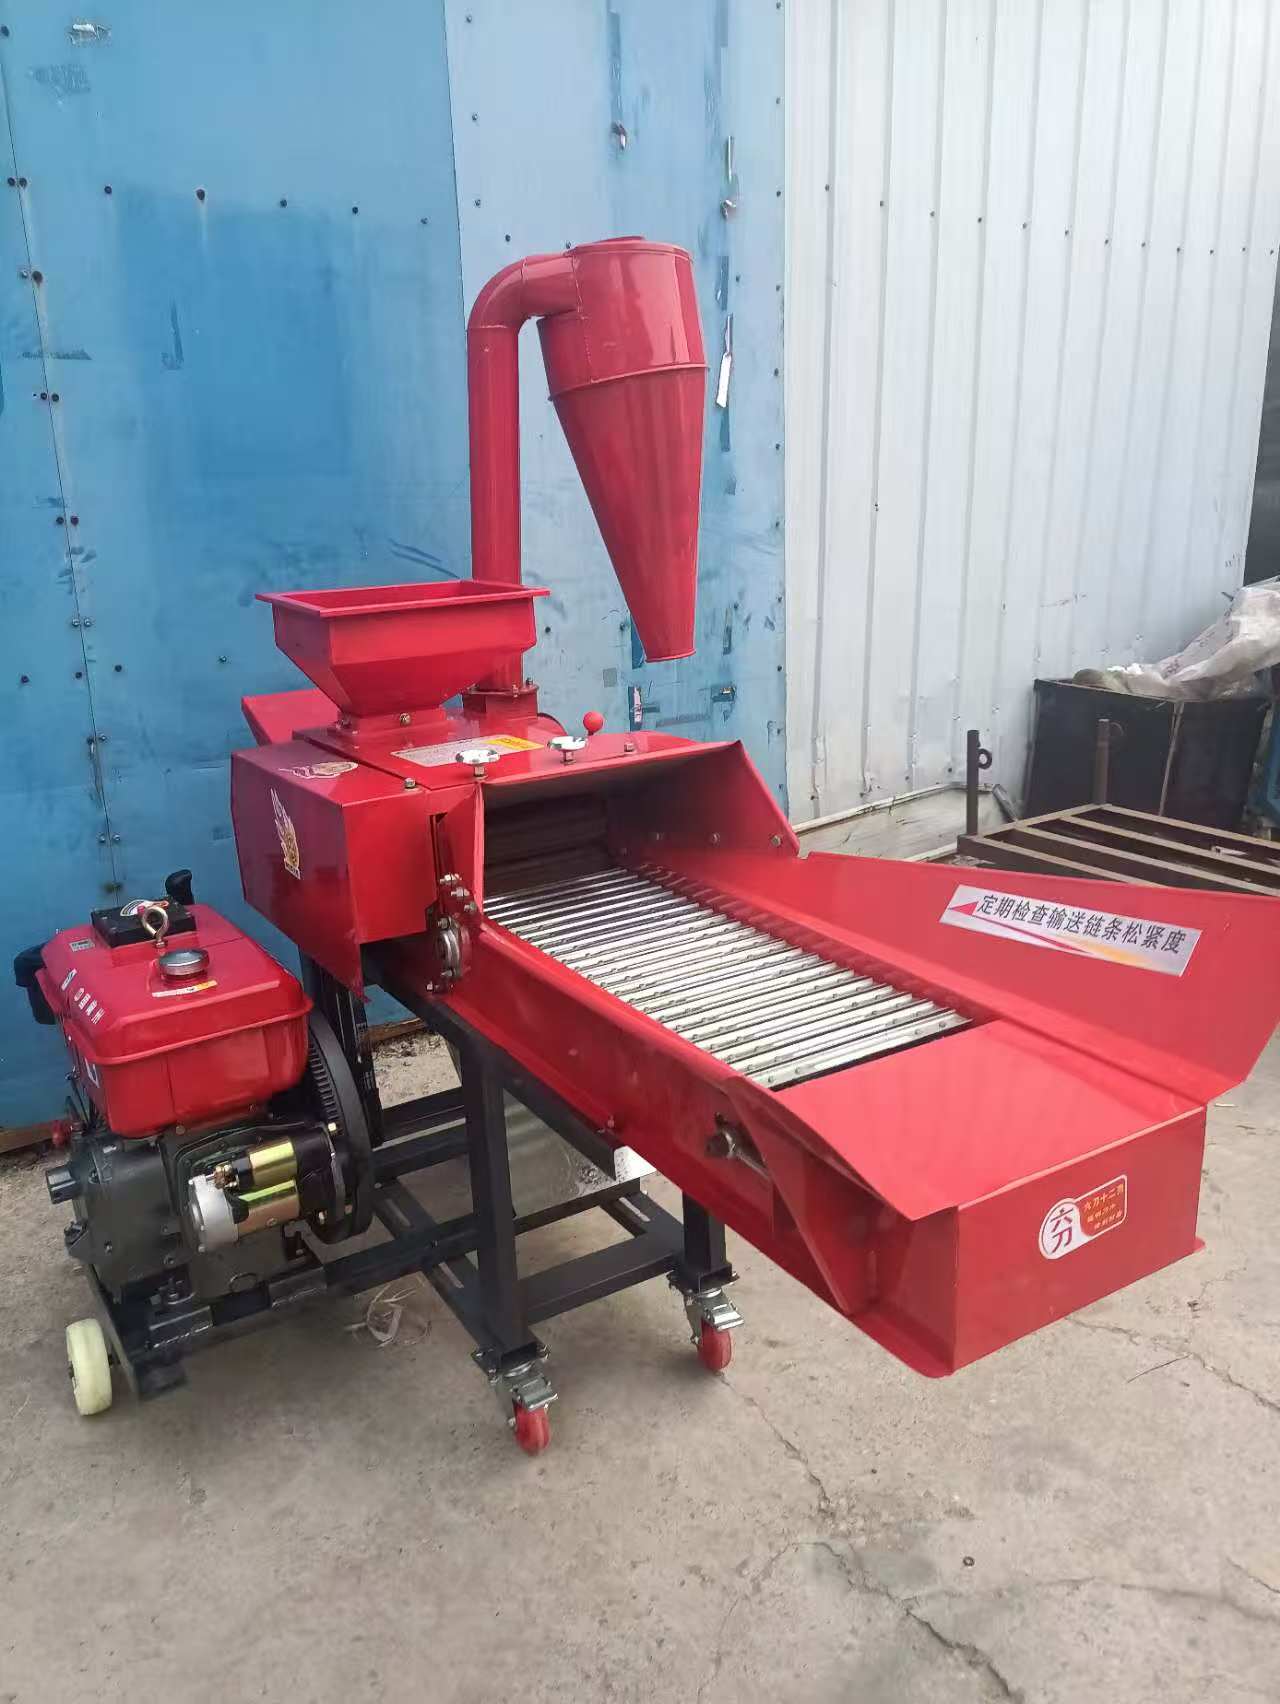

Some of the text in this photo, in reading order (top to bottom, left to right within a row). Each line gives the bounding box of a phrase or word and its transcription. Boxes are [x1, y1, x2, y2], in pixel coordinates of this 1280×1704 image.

[977, 895, 1187, 954] 定期检查输送链条松紧度
[1050, 1207, 1074, 1254] 六刀
